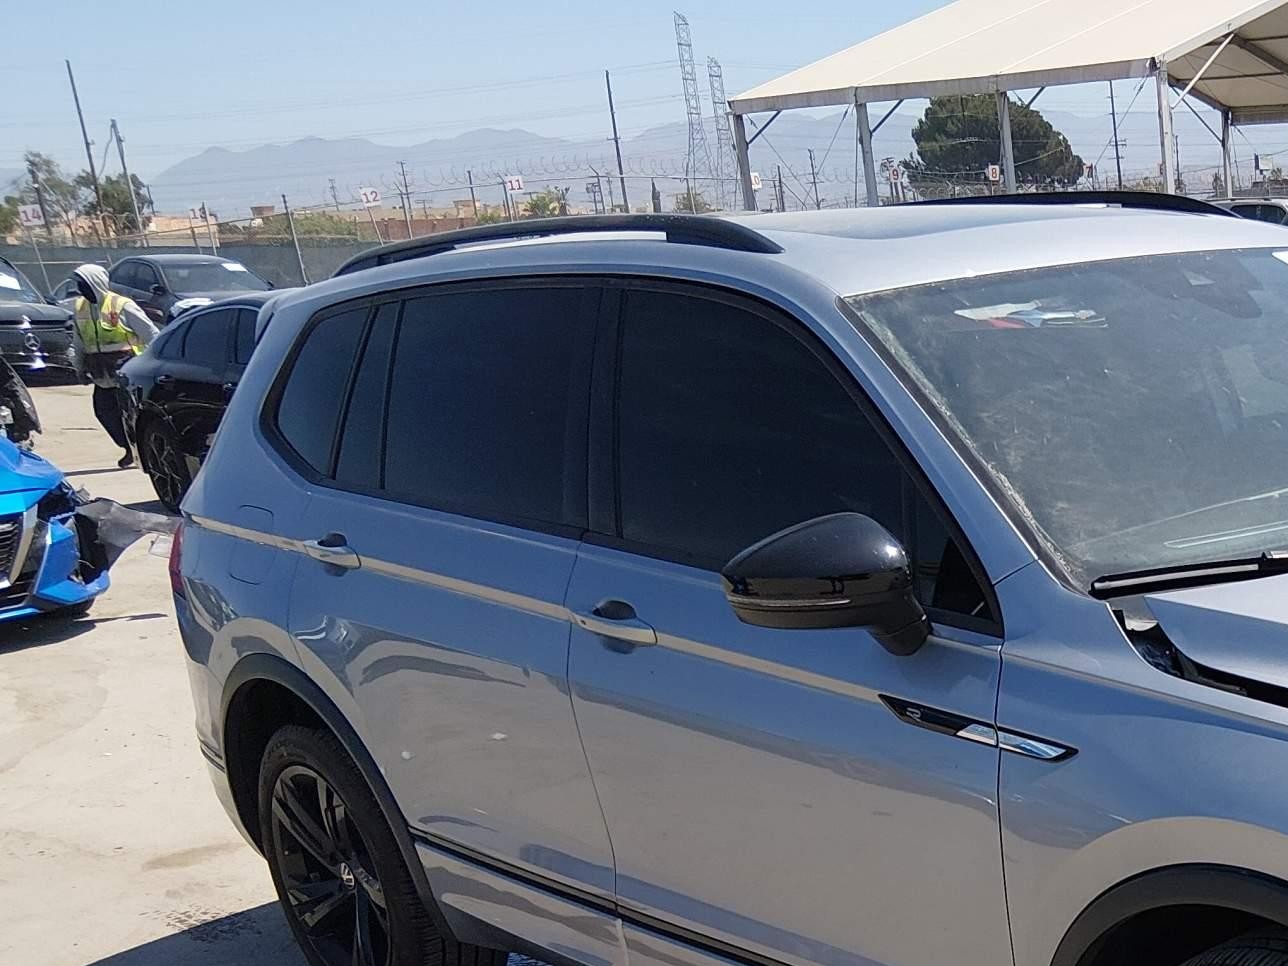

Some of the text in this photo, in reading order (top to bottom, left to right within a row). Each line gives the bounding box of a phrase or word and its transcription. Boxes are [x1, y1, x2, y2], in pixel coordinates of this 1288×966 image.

[891, 168, 899, 181] 9
[991, 167, 998, 179] 8
[508, 179, 523, 191] 11
[363, 190, 378, 203] 12
[21, 209, 42, 223] 14
